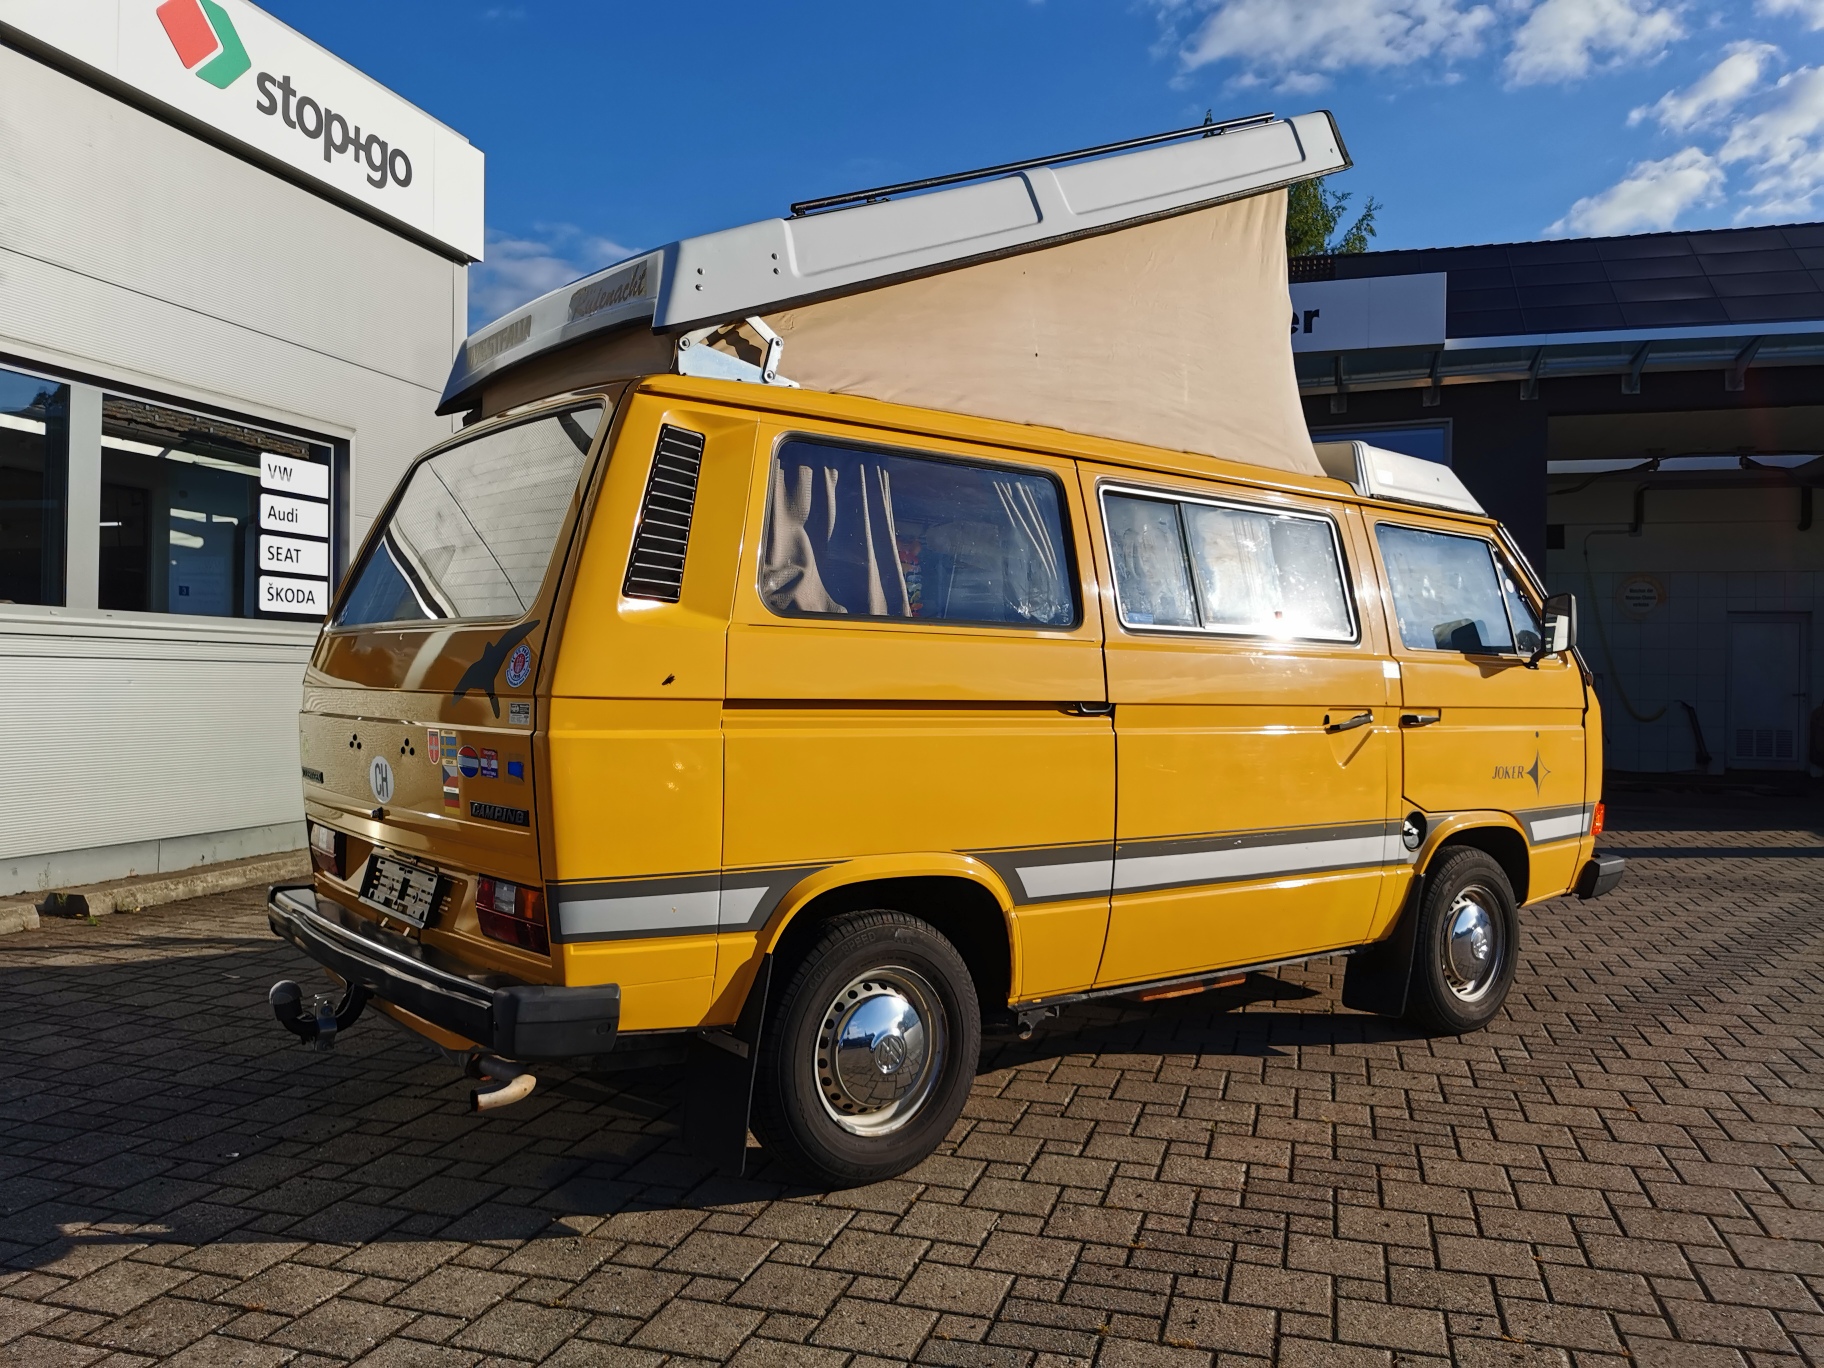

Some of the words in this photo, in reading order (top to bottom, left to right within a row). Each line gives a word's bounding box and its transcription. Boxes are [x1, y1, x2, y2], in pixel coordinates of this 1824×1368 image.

[256, 71, 413, 190] stop+go
[267, 463, 293, 482] VW
[267, 505, 298, 523] Audi
[267, 545, 302, 564] SEAT
[266, 582, 316, 605] ŠKODA
[374, 762, 389, 798] CH
[1492, 765, 1525, 779] JOKER
[472, 803, 525, 824] CAMPING
